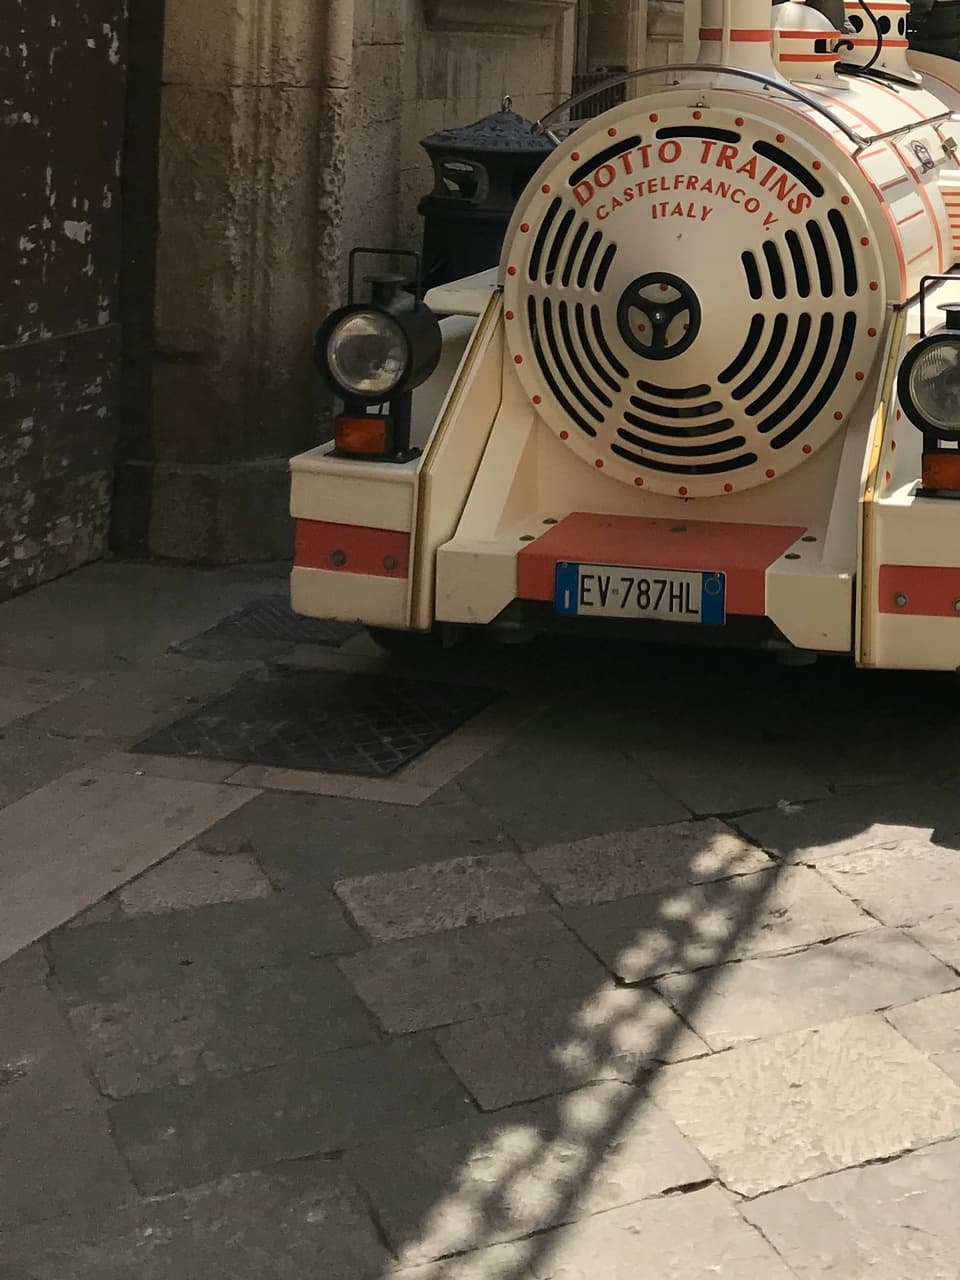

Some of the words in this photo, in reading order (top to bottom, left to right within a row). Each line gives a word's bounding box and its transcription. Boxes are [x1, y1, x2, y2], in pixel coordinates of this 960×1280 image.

[572, 140, 682, 207] DOTTO
[700, 140, 812, 214] TRAINS
[596, 174, 760, 221] CASTELFRANCO
[762, 211, 779, 231] V.
[651, 202, 712, 221] ITALY
